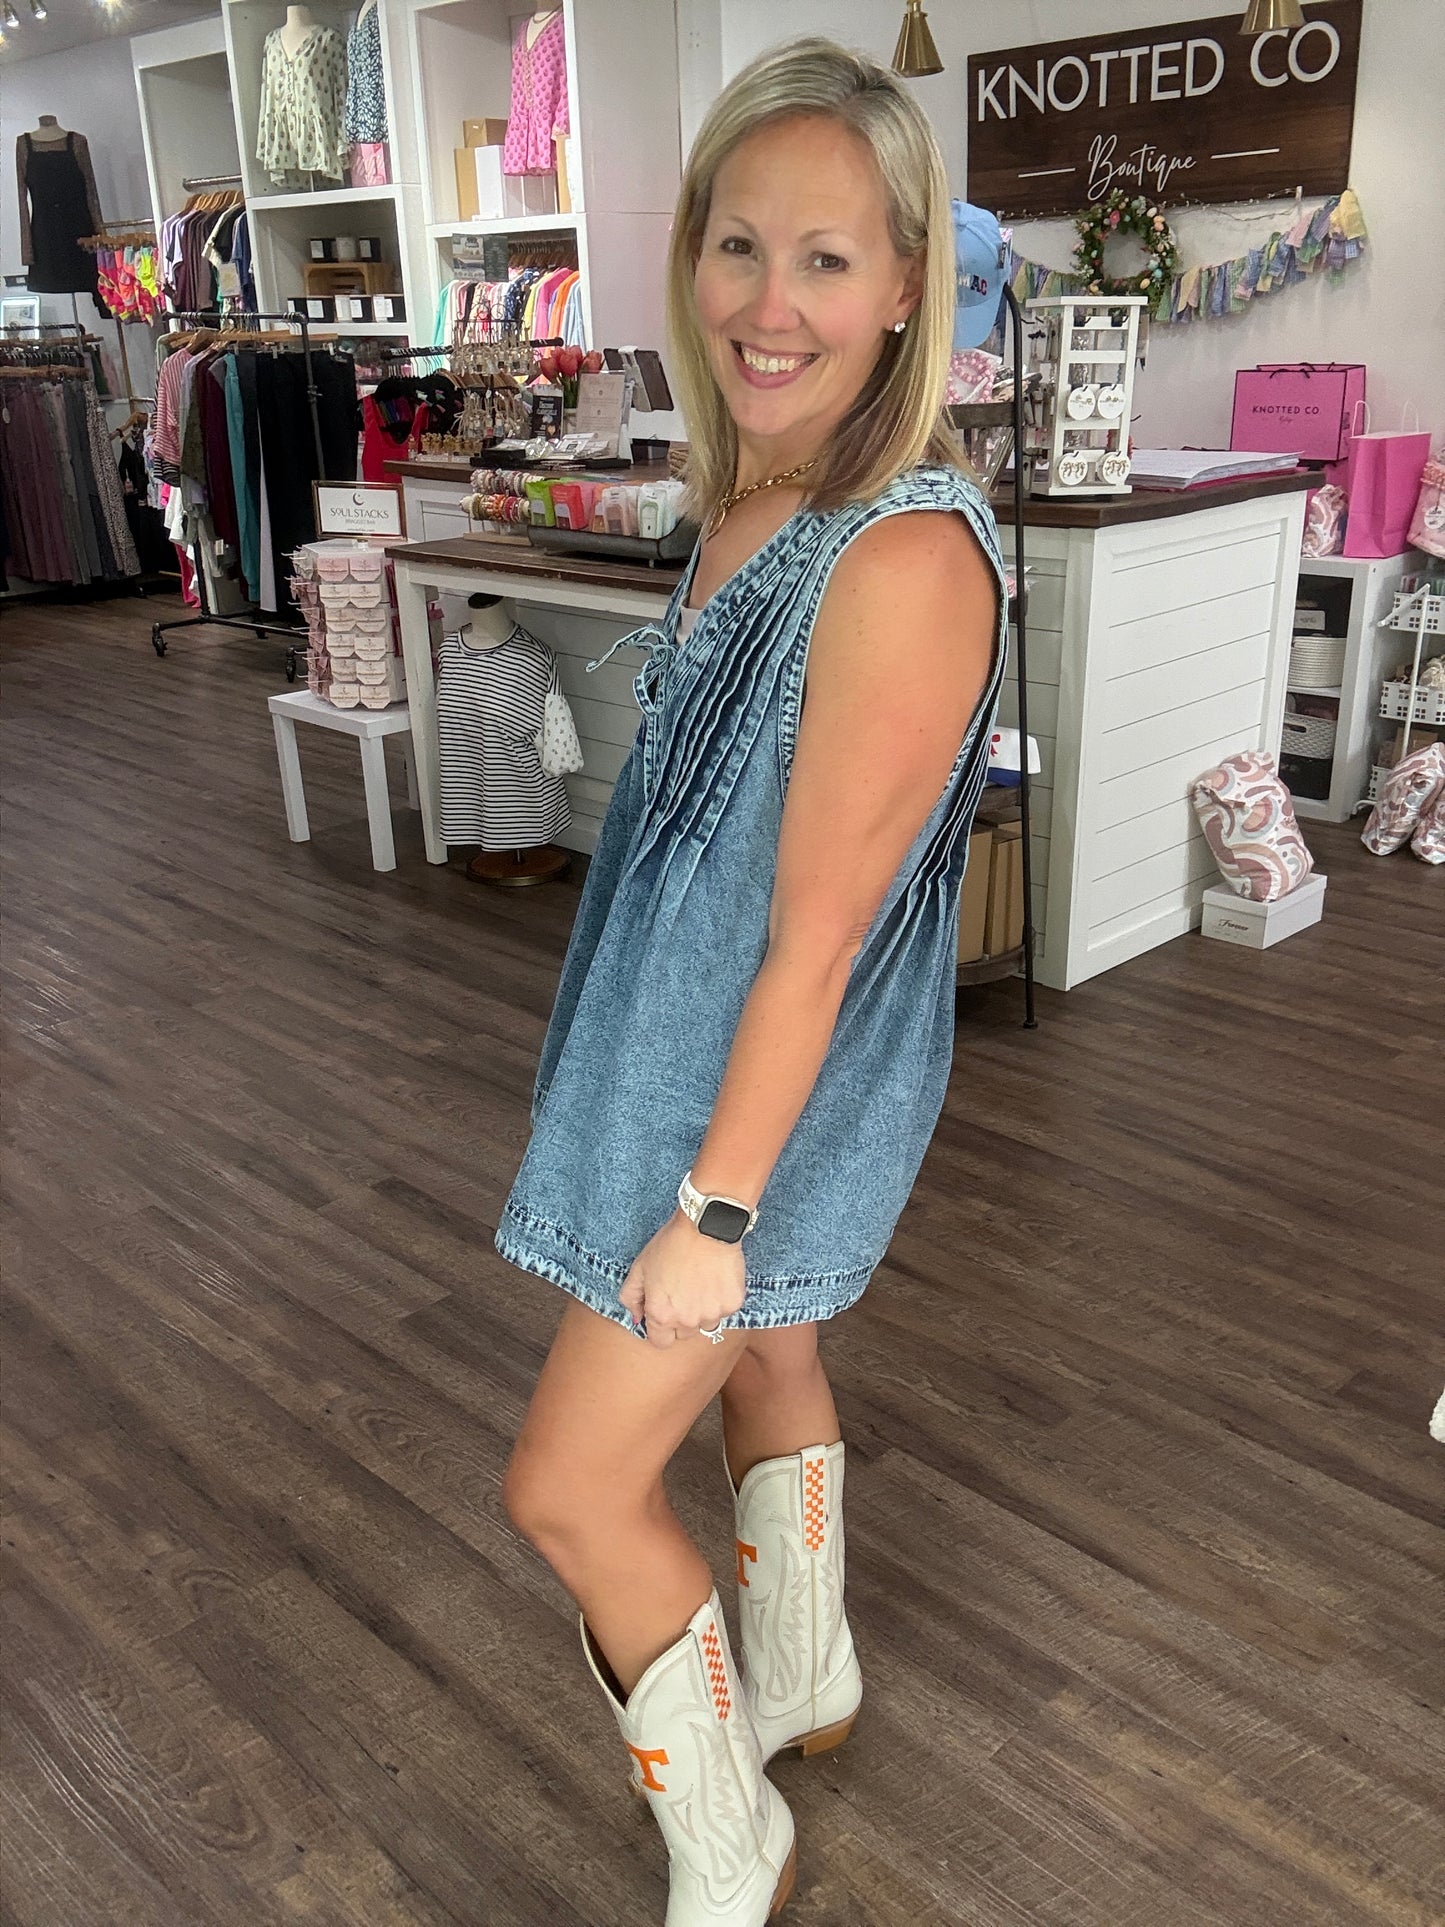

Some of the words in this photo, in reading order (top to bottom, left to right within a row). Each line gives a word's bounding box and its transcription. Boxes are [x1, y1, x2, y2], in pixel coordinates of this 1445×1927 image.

[977, 38, 1225, 122] KNOTTED
[1249, 20, 1341, 88] CO
[1087, 134, 1197, 200] Boutique
[1252, 405, 1301, 415] KNOTTED
[1304, 406, 1320, 415] CO
[330, 507, 353, 518] SOUL
[354, 508, 389, 519] STACKS
[624, 1739, 670, 1792] T
